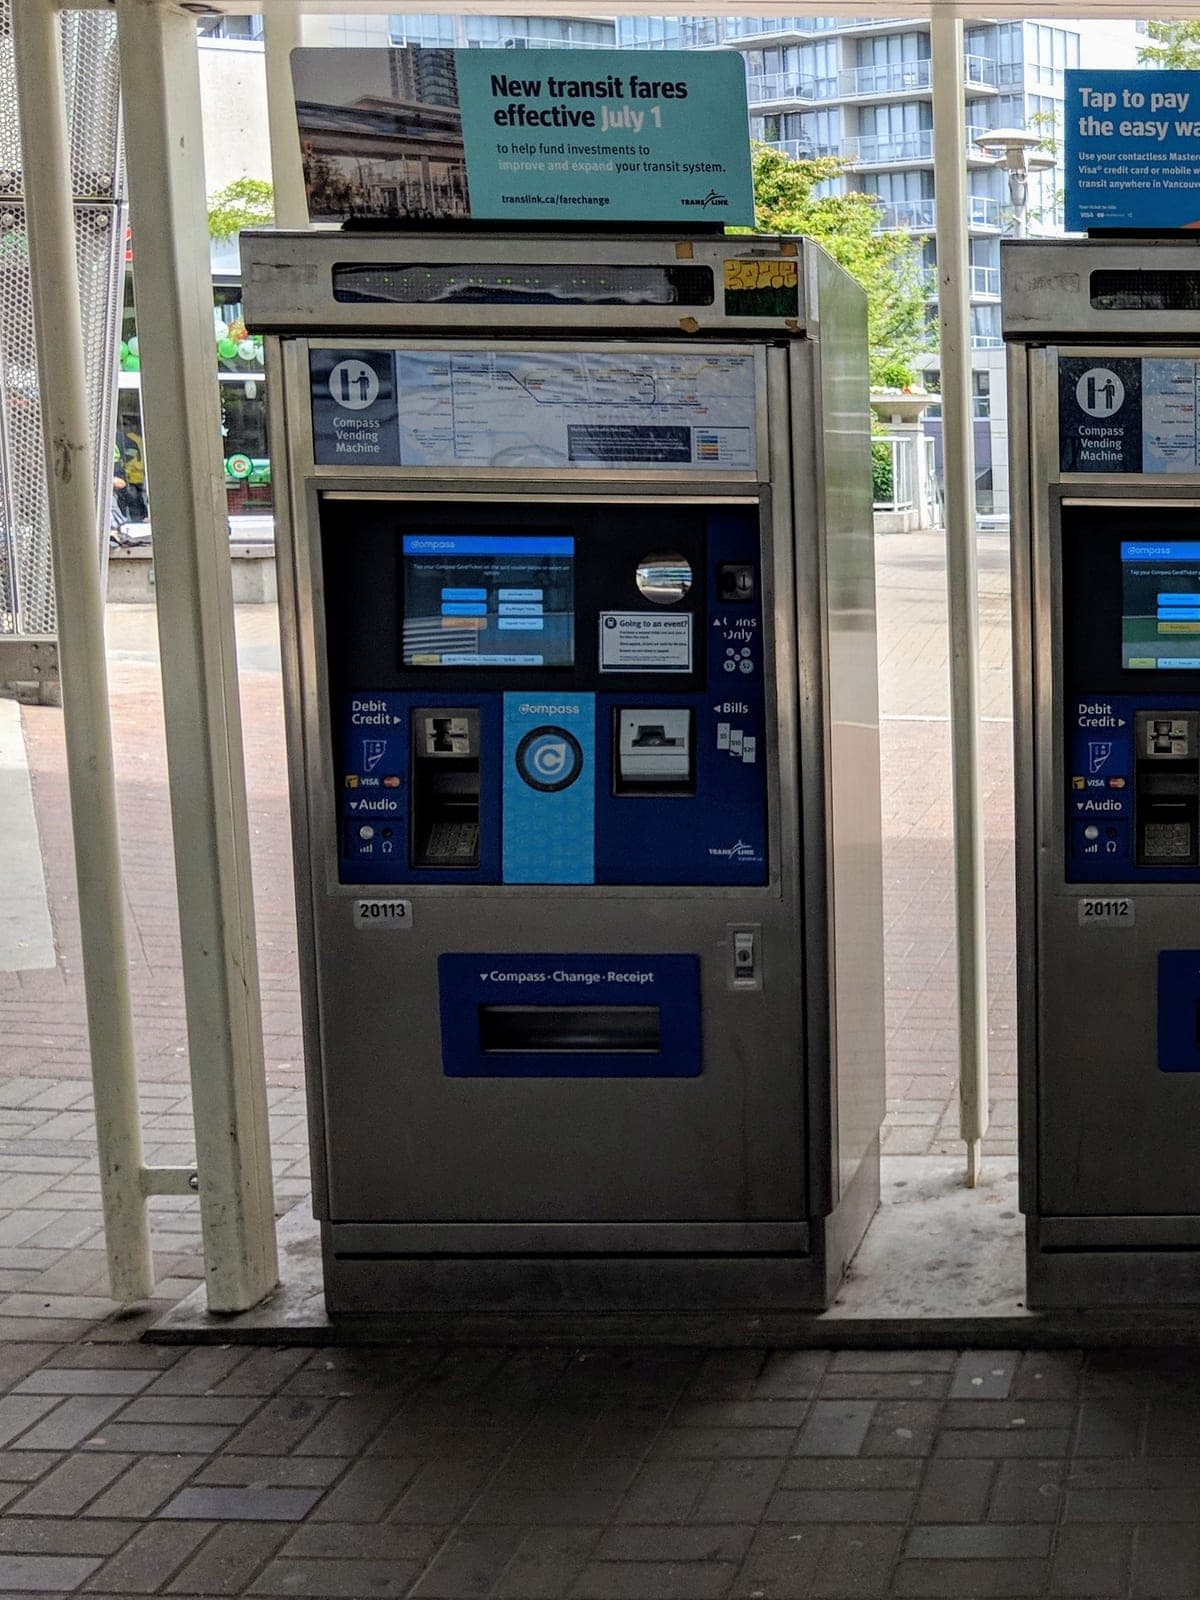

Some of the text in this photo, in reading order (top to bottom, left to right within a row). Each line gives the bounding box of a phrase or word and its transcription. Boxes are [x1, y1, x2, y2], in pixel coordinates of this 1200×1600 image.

[491, 75, 688, 99] New transit fares
[1078, 88, 1189, 112] Tap to pay
[494, 104, 662, 132] effective July 1
[1079, 116, 1113, 136] the
[1120, 121, 1168, 141] easy
[498, 144, 650, 157] to help fund investments to
[1079, 152, 1095, 161] Use
[1097, 153, 1116, 162] your
[1118, 152, 1167, 161] contactless
[498, 160, 726, 174] improve and expand your transit system.
[1104, 166, 1128, 174] credit
[1131, 166, 1148, 174] card
[1162, 166, 1191, 175] mobile
[1079, 179, 1107, 188] transit
[1109, 180, 1150, 190] anywhere
[1153, 180, 1161, 188] in
[502, 194, 610, 206] translink.ca/farechange
[333, 417, 380, 430] Compass
[336, 430, 378, 442] Vending
[1078, 425, 1124, 438] Compass
[336, 443, 380, 454] Machine
[1080, 438, 1121, 450] Vending
[1080, 450, 1123, 462] Machine
[410, 541, 455, 551] Compass
[1128, 546, 1171, 556] Compass
[620, 620, 641, 628] Going
[723, 616, 756, 627] ins
[352, 700, 387, 712] Debit
[519, 703, 579, 715] Compass
[723, 702, 749, 714] Bills
[1078, 704, 1112, 714] Debit
[352, 713, 391, 725] Credit
[1078, 716, 1116, 727] Credit
[358, 799, 398, 810] Audio
[1085, 800, 1122, 811] Audio
[360, 903, 406, 918] 20113
[1084, 902, 1128, 916] 20112
[490, 970, 654, 984] Compass Change Receipt
